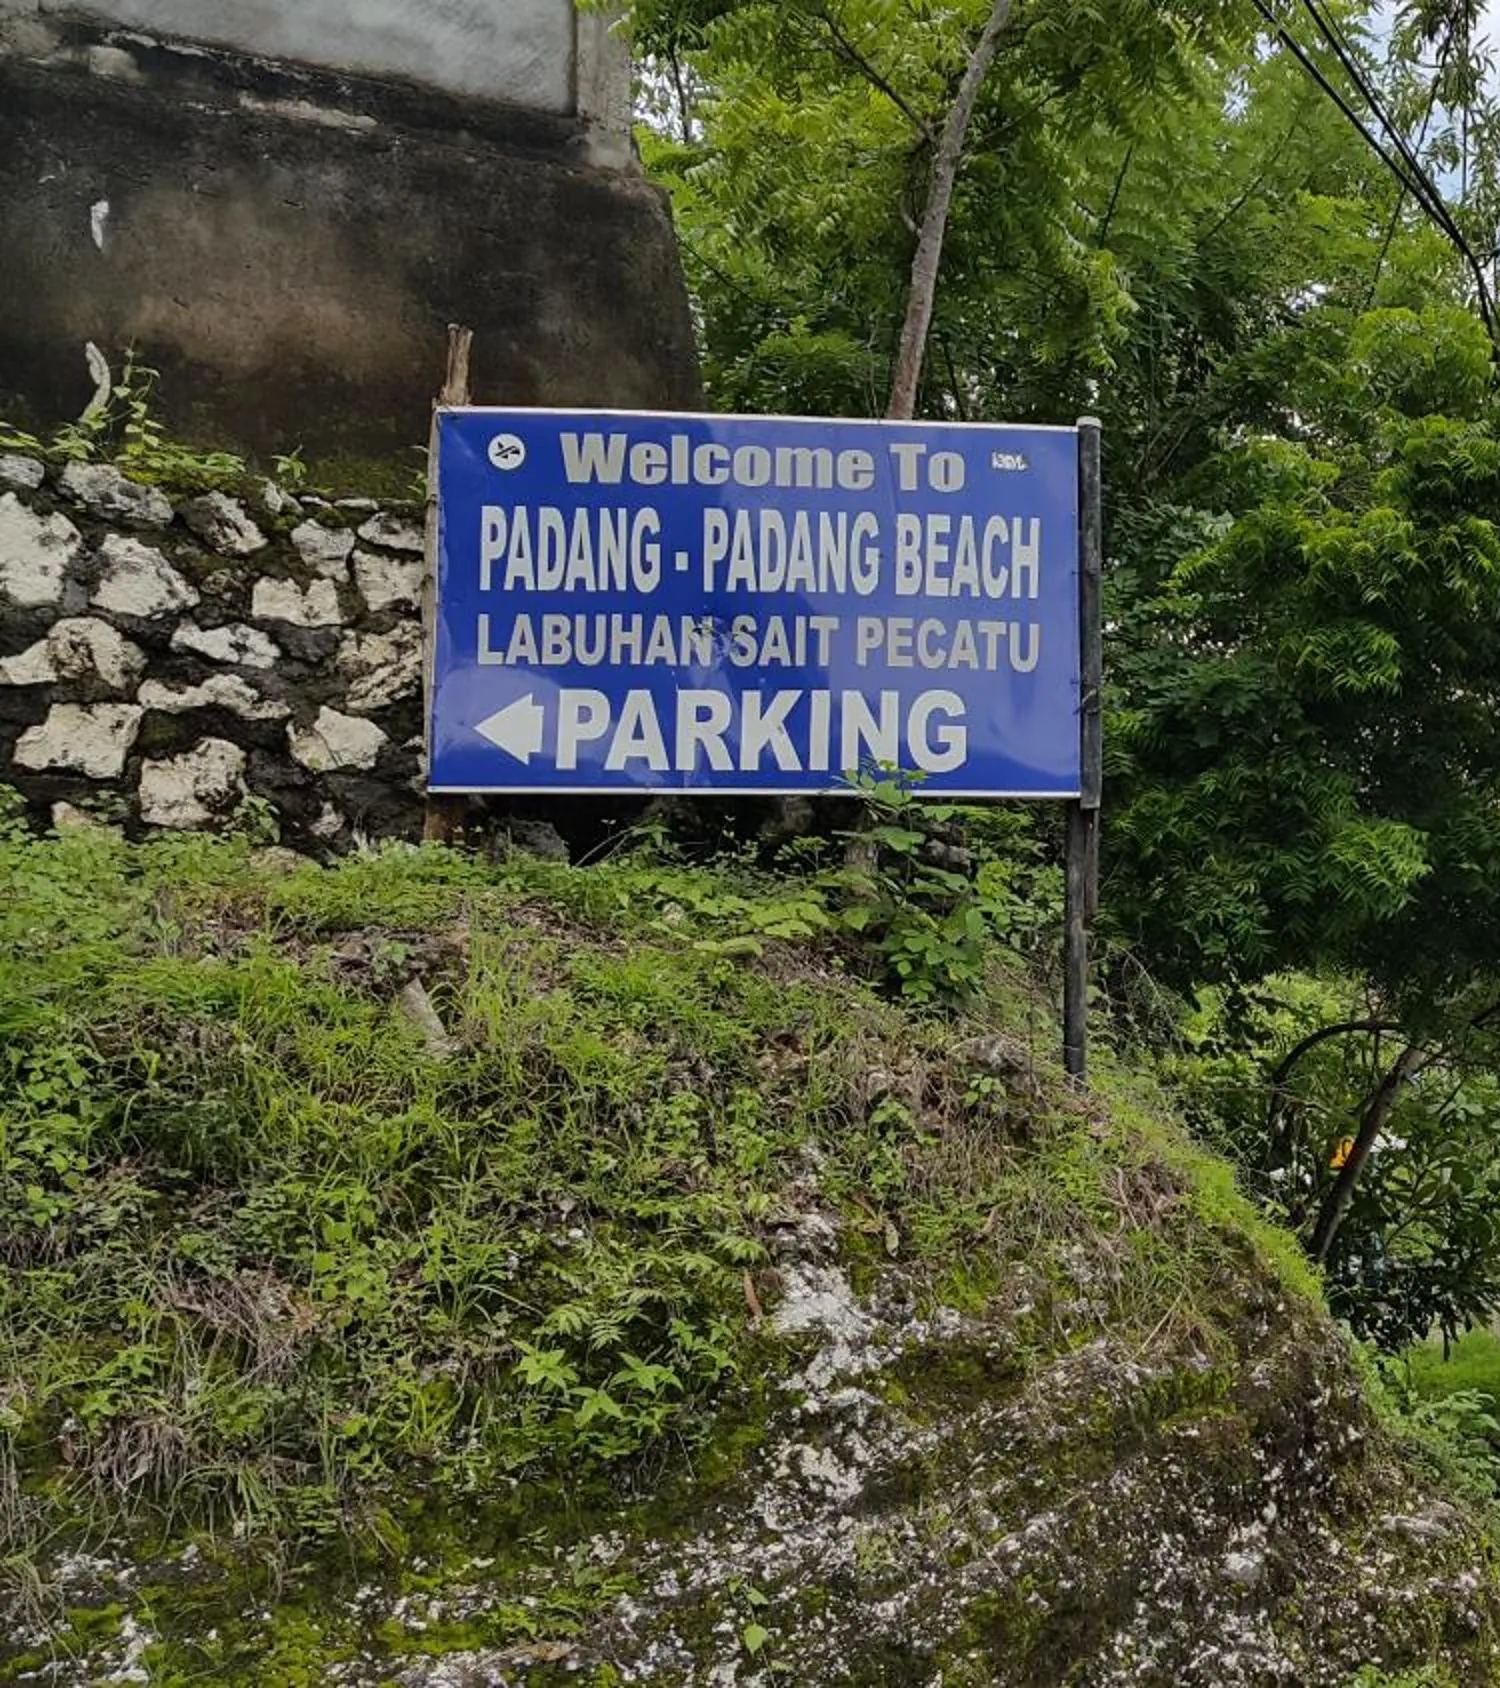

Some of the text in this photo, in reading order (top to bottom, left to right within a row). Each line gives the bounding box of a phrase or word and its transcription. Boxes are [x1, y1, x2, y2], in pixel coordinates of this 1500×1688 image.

[560, 433, 966, 492] Welcome To
[479, 505, 661, 594] PADANG
[703, 508, 880, 596] PADANG
[895, 513, 1040, 599] BEACH
[477, 613, 1040, 673] LABUHAN SAIT PECATU
[555, 689, 968, 773] PARKING
